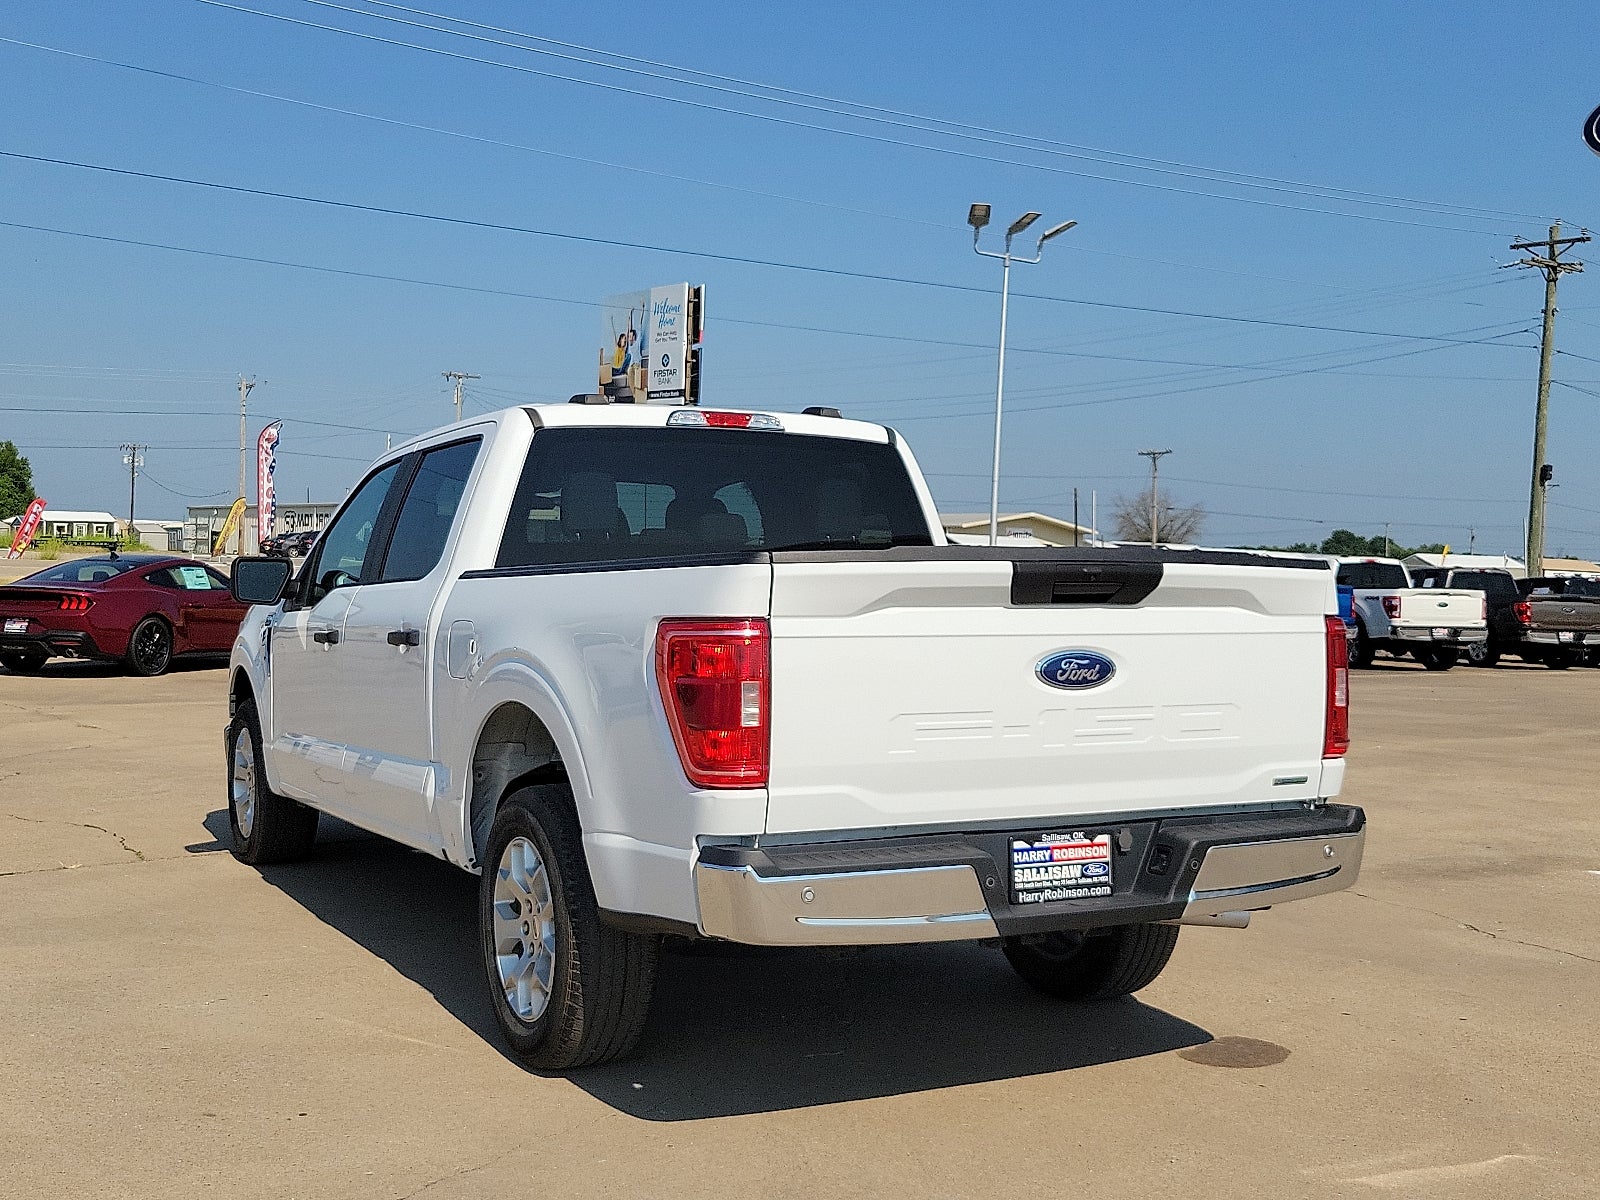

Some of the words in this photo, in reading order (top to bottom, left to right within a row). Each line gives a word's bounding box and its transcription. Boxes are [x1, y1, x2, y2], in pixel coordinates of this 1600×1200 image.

[653, 298, 681, 316] Welcome
[658, 316, 676, 329] Home
[653, 369, 678, 378] FIRSTAR
[658, 377, 672, 386] BANK
[1057, 659, 1100, 681] Ford
[1014, 850, 1051, 863] HARRY
[1053, 846, 1107, 860] ROBINSON
[1015, 865, 1082, 882] SALLISAW
[1019, 886, 1112, 903] HarryRobinson.com
